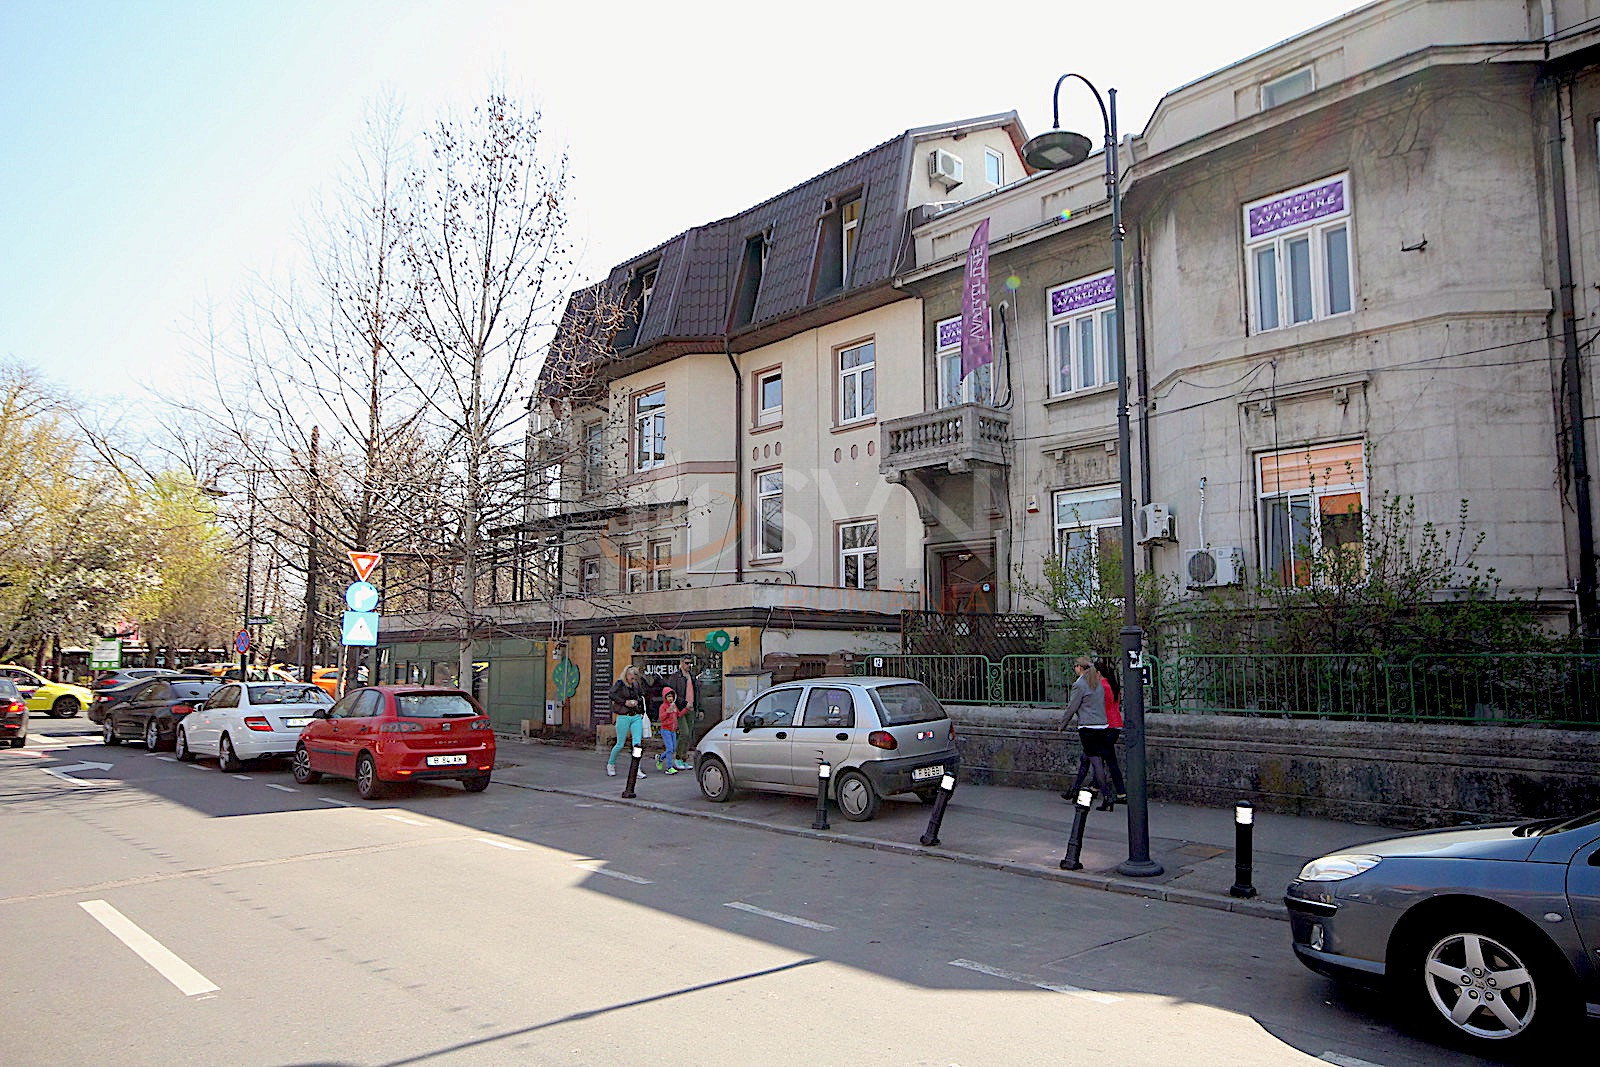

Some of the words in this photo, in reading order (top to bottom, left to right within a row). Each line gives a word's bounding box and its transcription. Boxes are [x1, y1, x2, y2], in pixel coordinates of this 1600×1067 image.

[1257, 195, 1336, 226] AVANTLINE
[1057, 285, 1112, 307] AVANTLINE
[644, 664, 667, 676] JUICE
